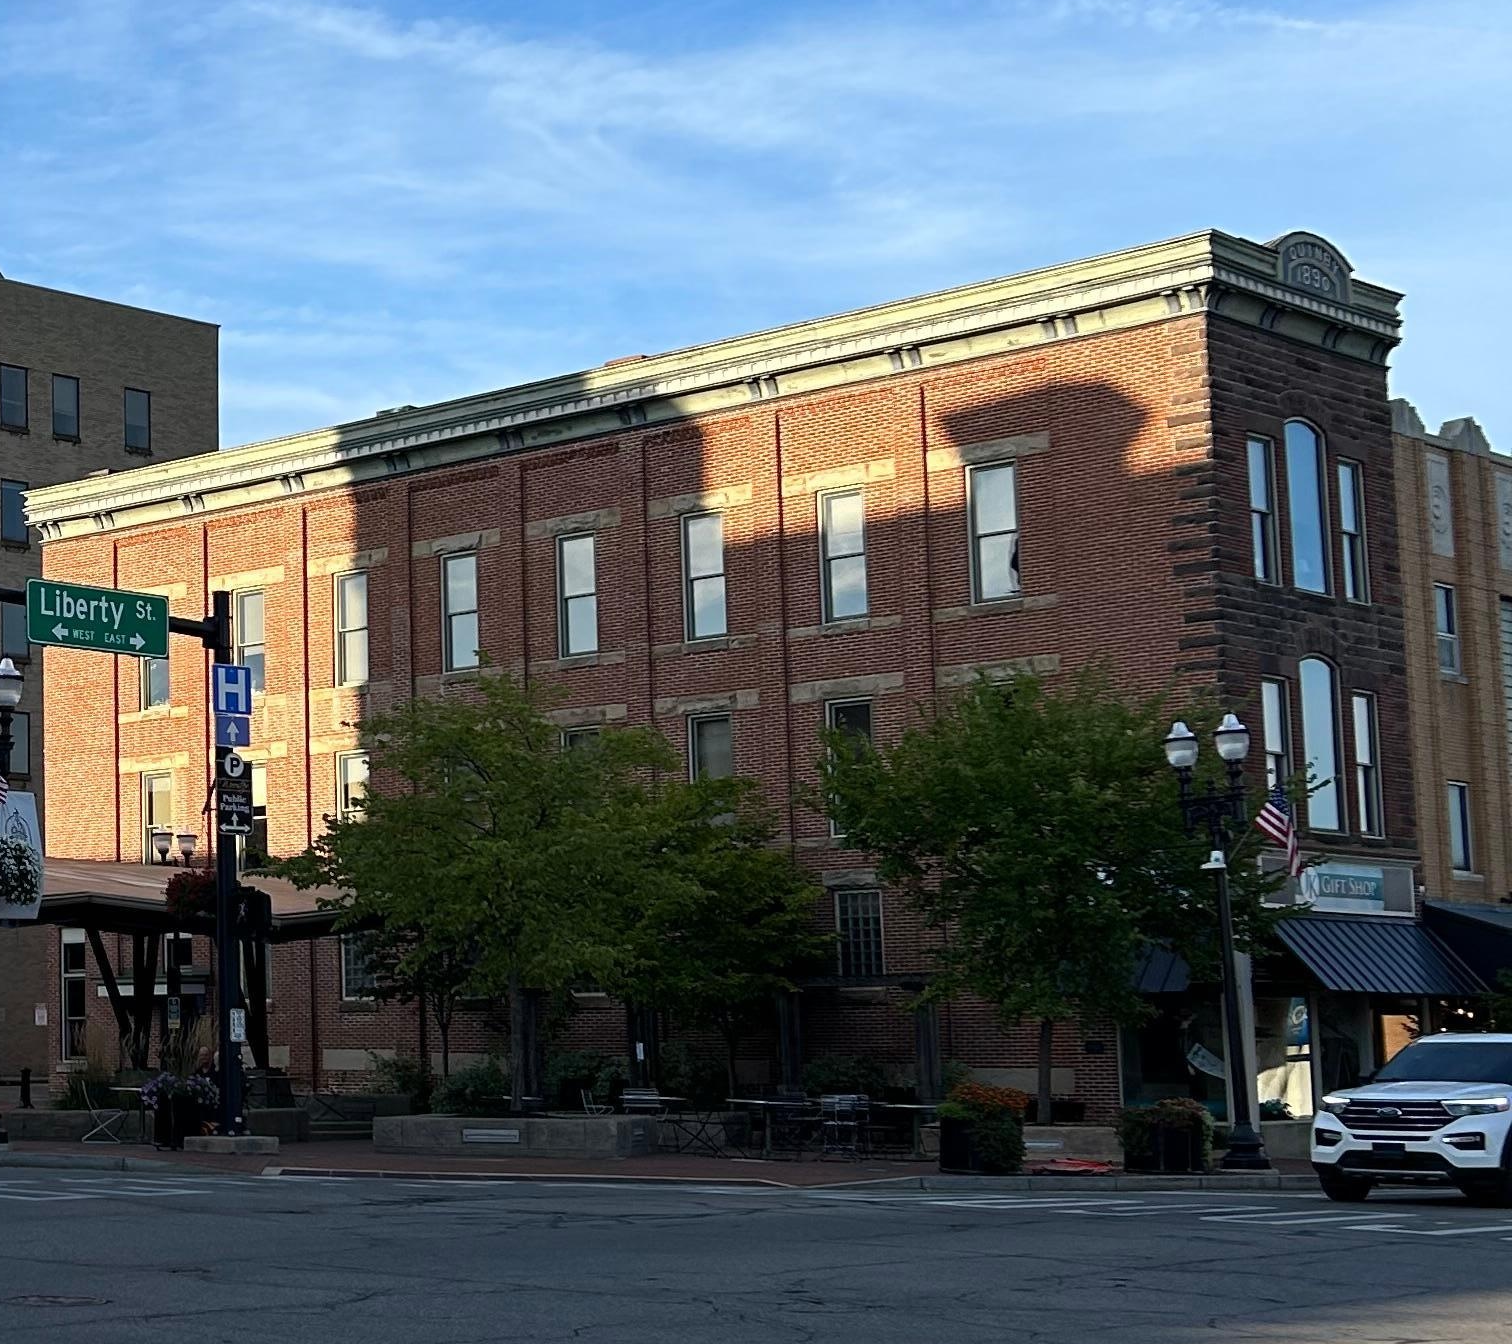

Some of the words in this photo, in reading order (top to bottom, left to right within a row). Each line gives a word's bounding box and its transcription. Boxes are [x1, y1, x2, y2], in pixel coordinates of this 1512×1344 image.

[40, 586, 124, 630] Liberty
[135, 600, 157, 621] St.
[72, 628, 95, 641] WEST
[104, 632, 127, 645] EAST
[217, 667, 247, 712] H
[230, 757, 240, 774] P
[222, 794, 247, 803] Public
[220, 802, 250, 814] Parking
